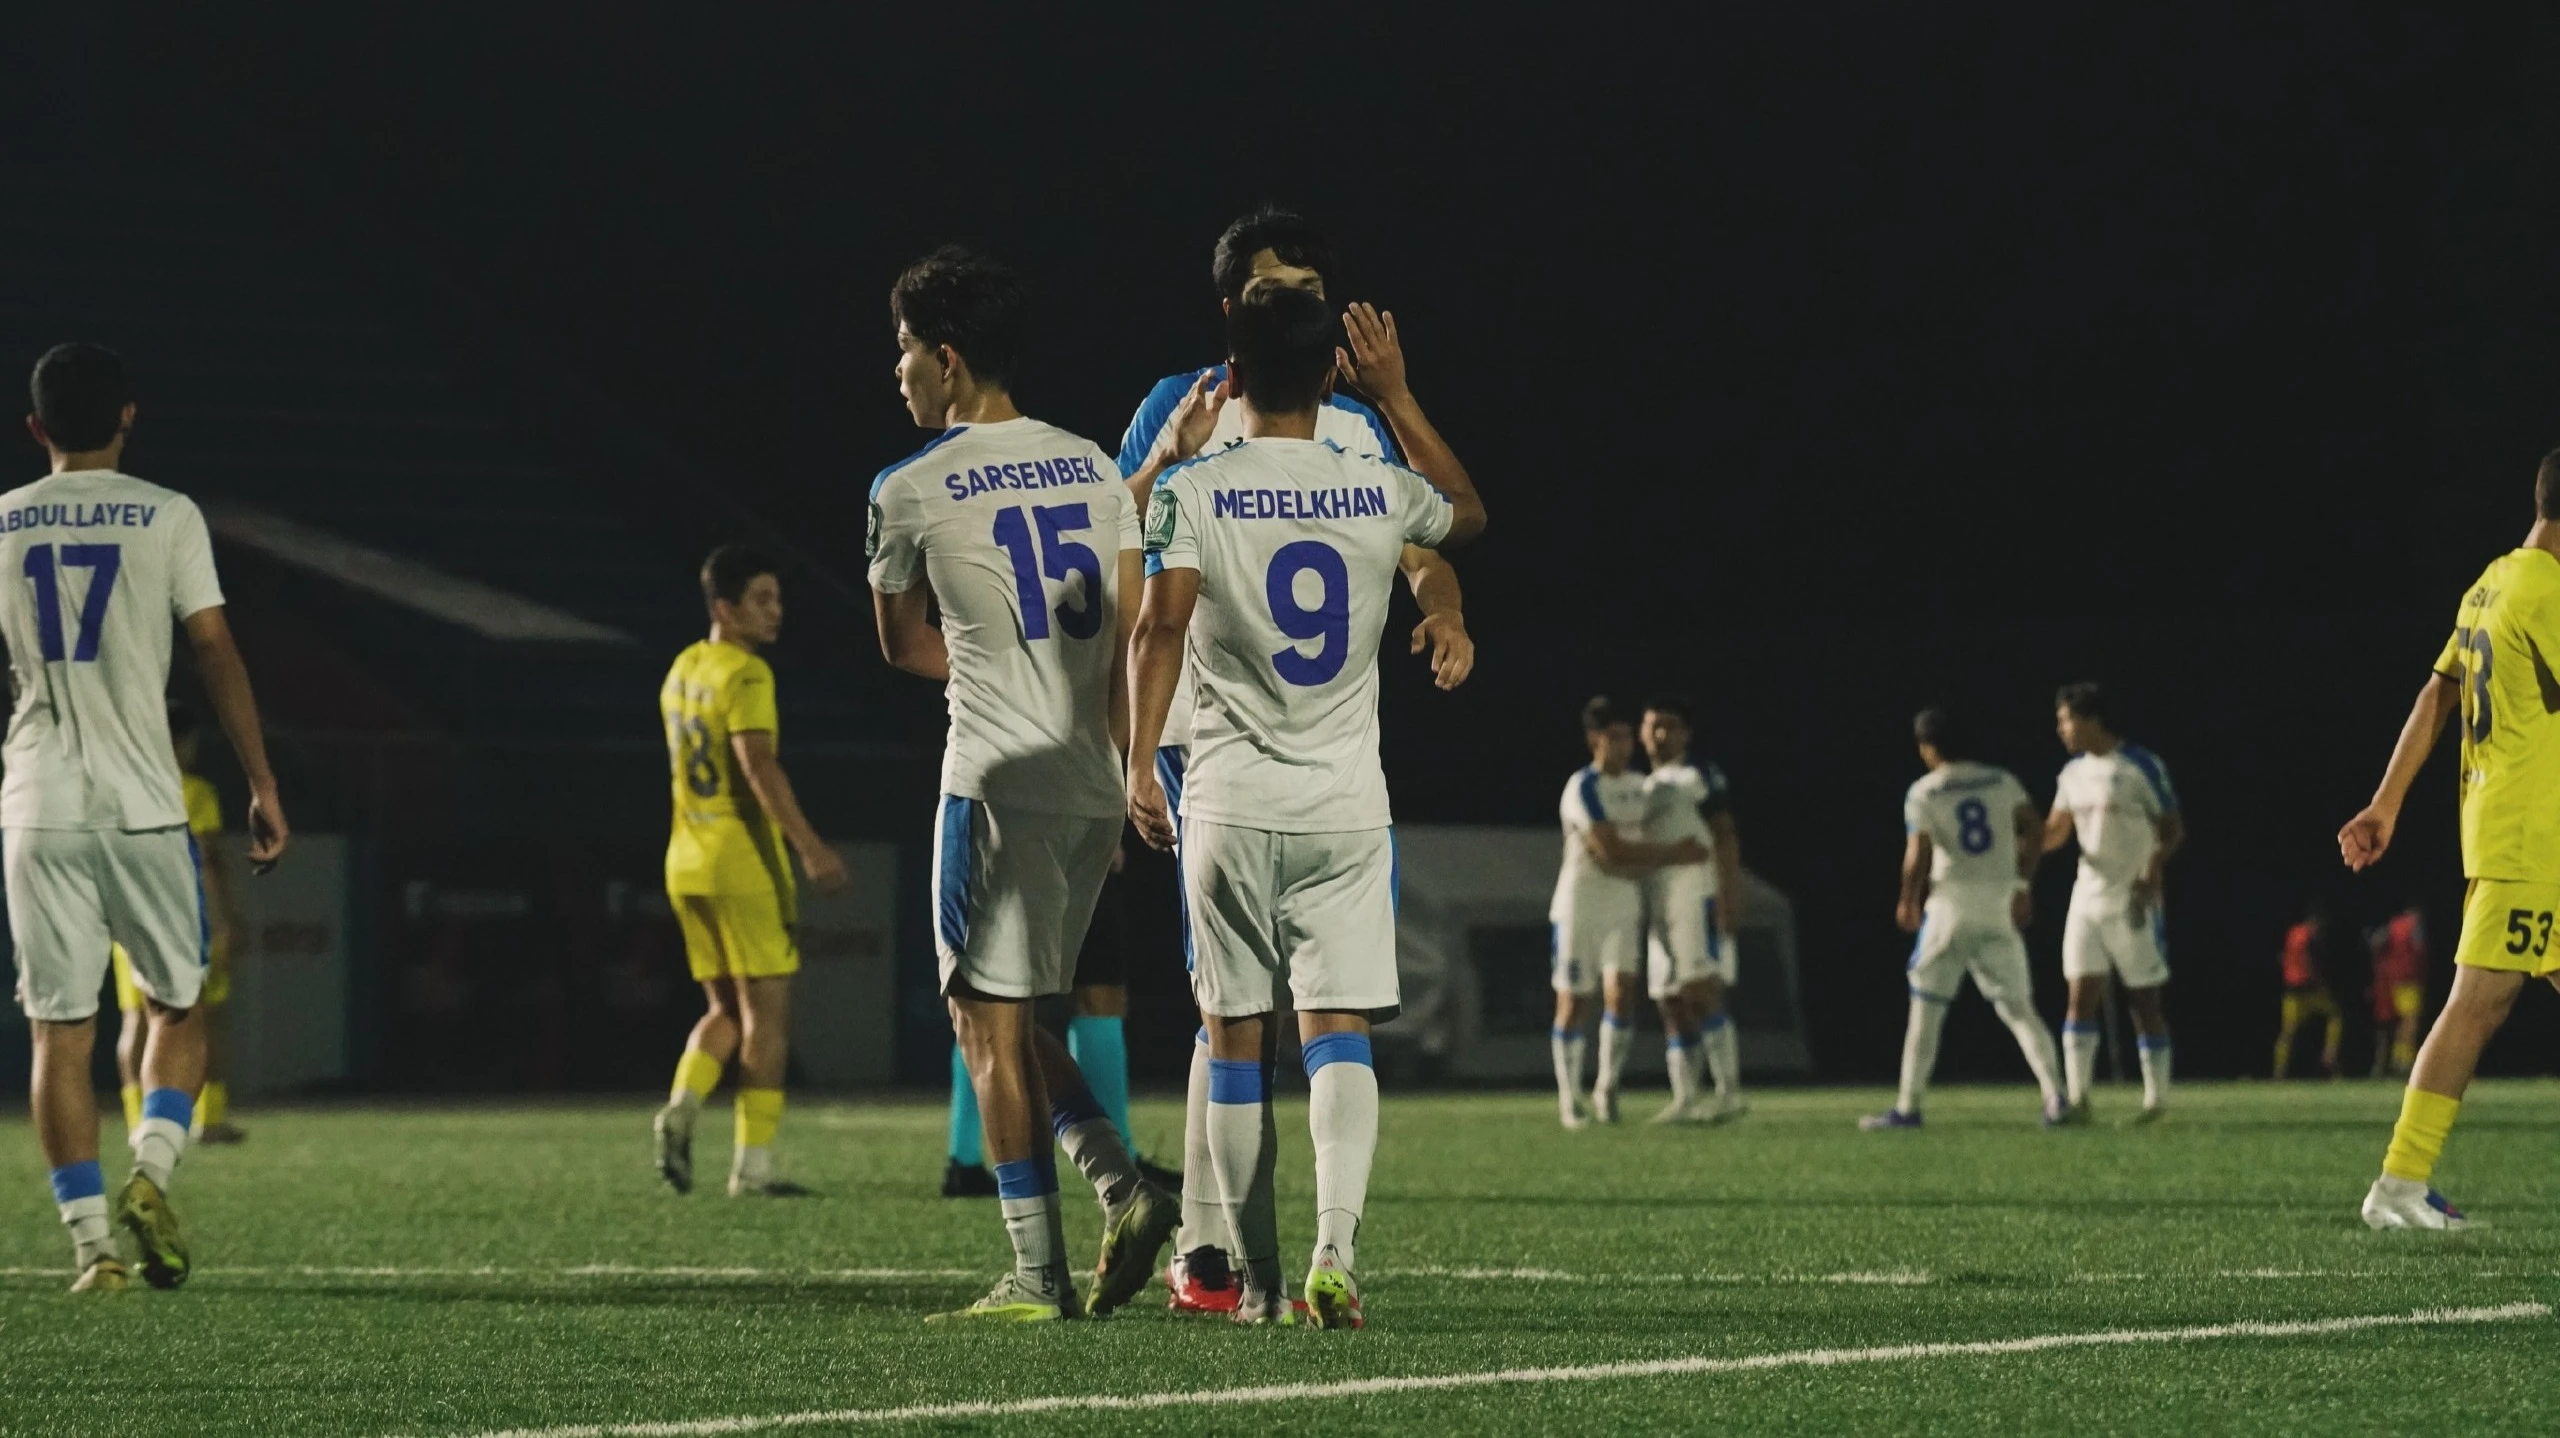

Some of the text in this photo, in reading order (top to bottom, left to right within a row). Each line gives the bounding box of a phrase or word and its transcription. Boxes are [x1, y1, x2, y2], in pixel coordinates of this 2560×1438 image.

[945, 457, 1104, 500] SARSENBEK
[1214, 486, 1387, 519] MEDELKHAN
[993, 503, 1101, 640] 15
[23, 543, 120, 662] 17
[1266, 541, 1349, 686] 9
[1956, 797, 1993, 855] 8
[2506, 909, 2552, 956] 53
